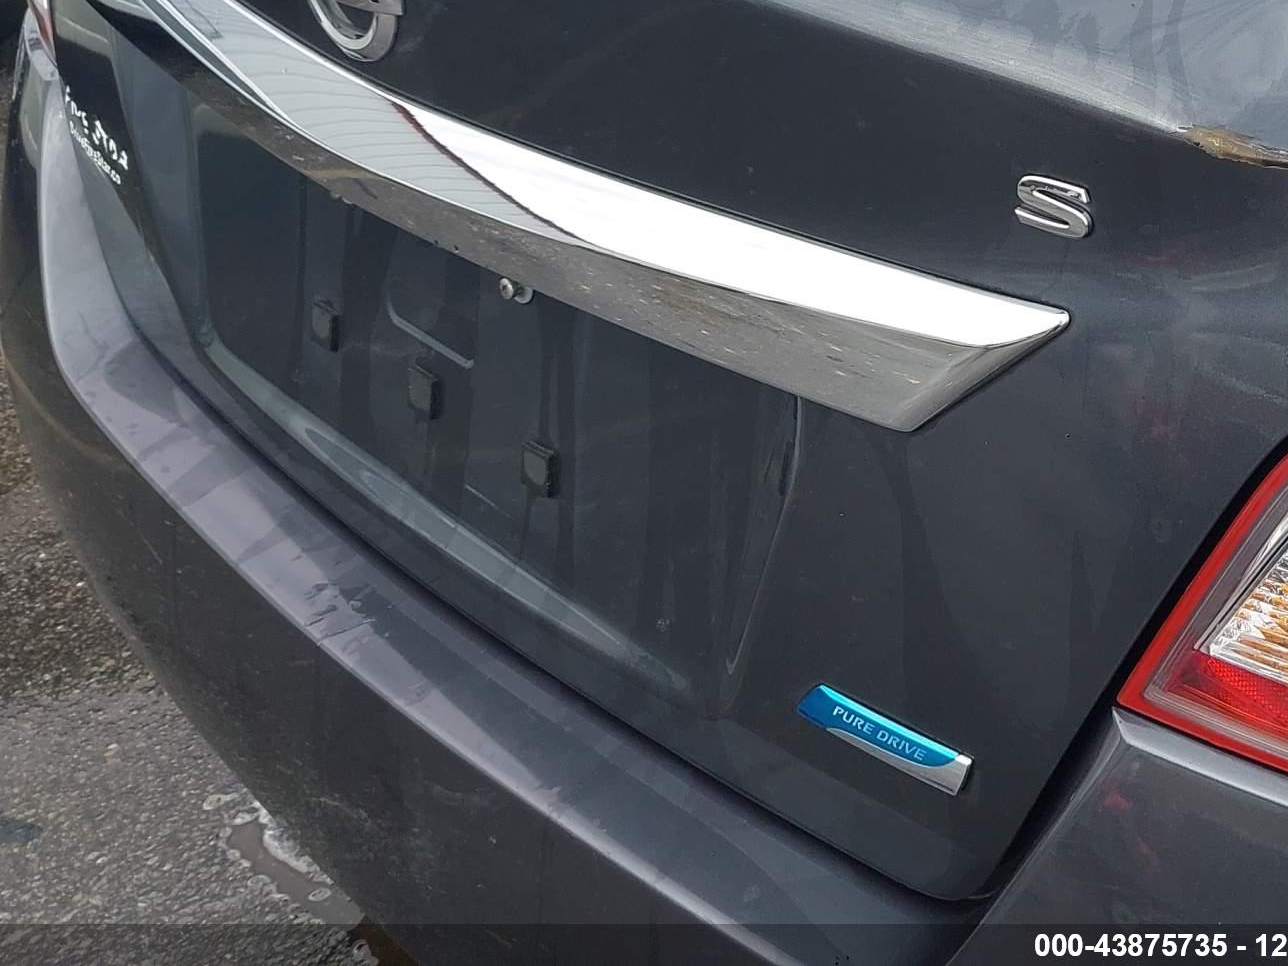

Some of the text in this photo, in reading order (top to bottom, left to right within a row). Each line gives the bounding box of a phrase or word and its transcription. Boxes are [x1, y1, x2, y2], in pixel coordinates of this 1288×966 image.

[1014, 175, 1092, 238] S
[832, 705, 927, 761] PURE DRIVE
